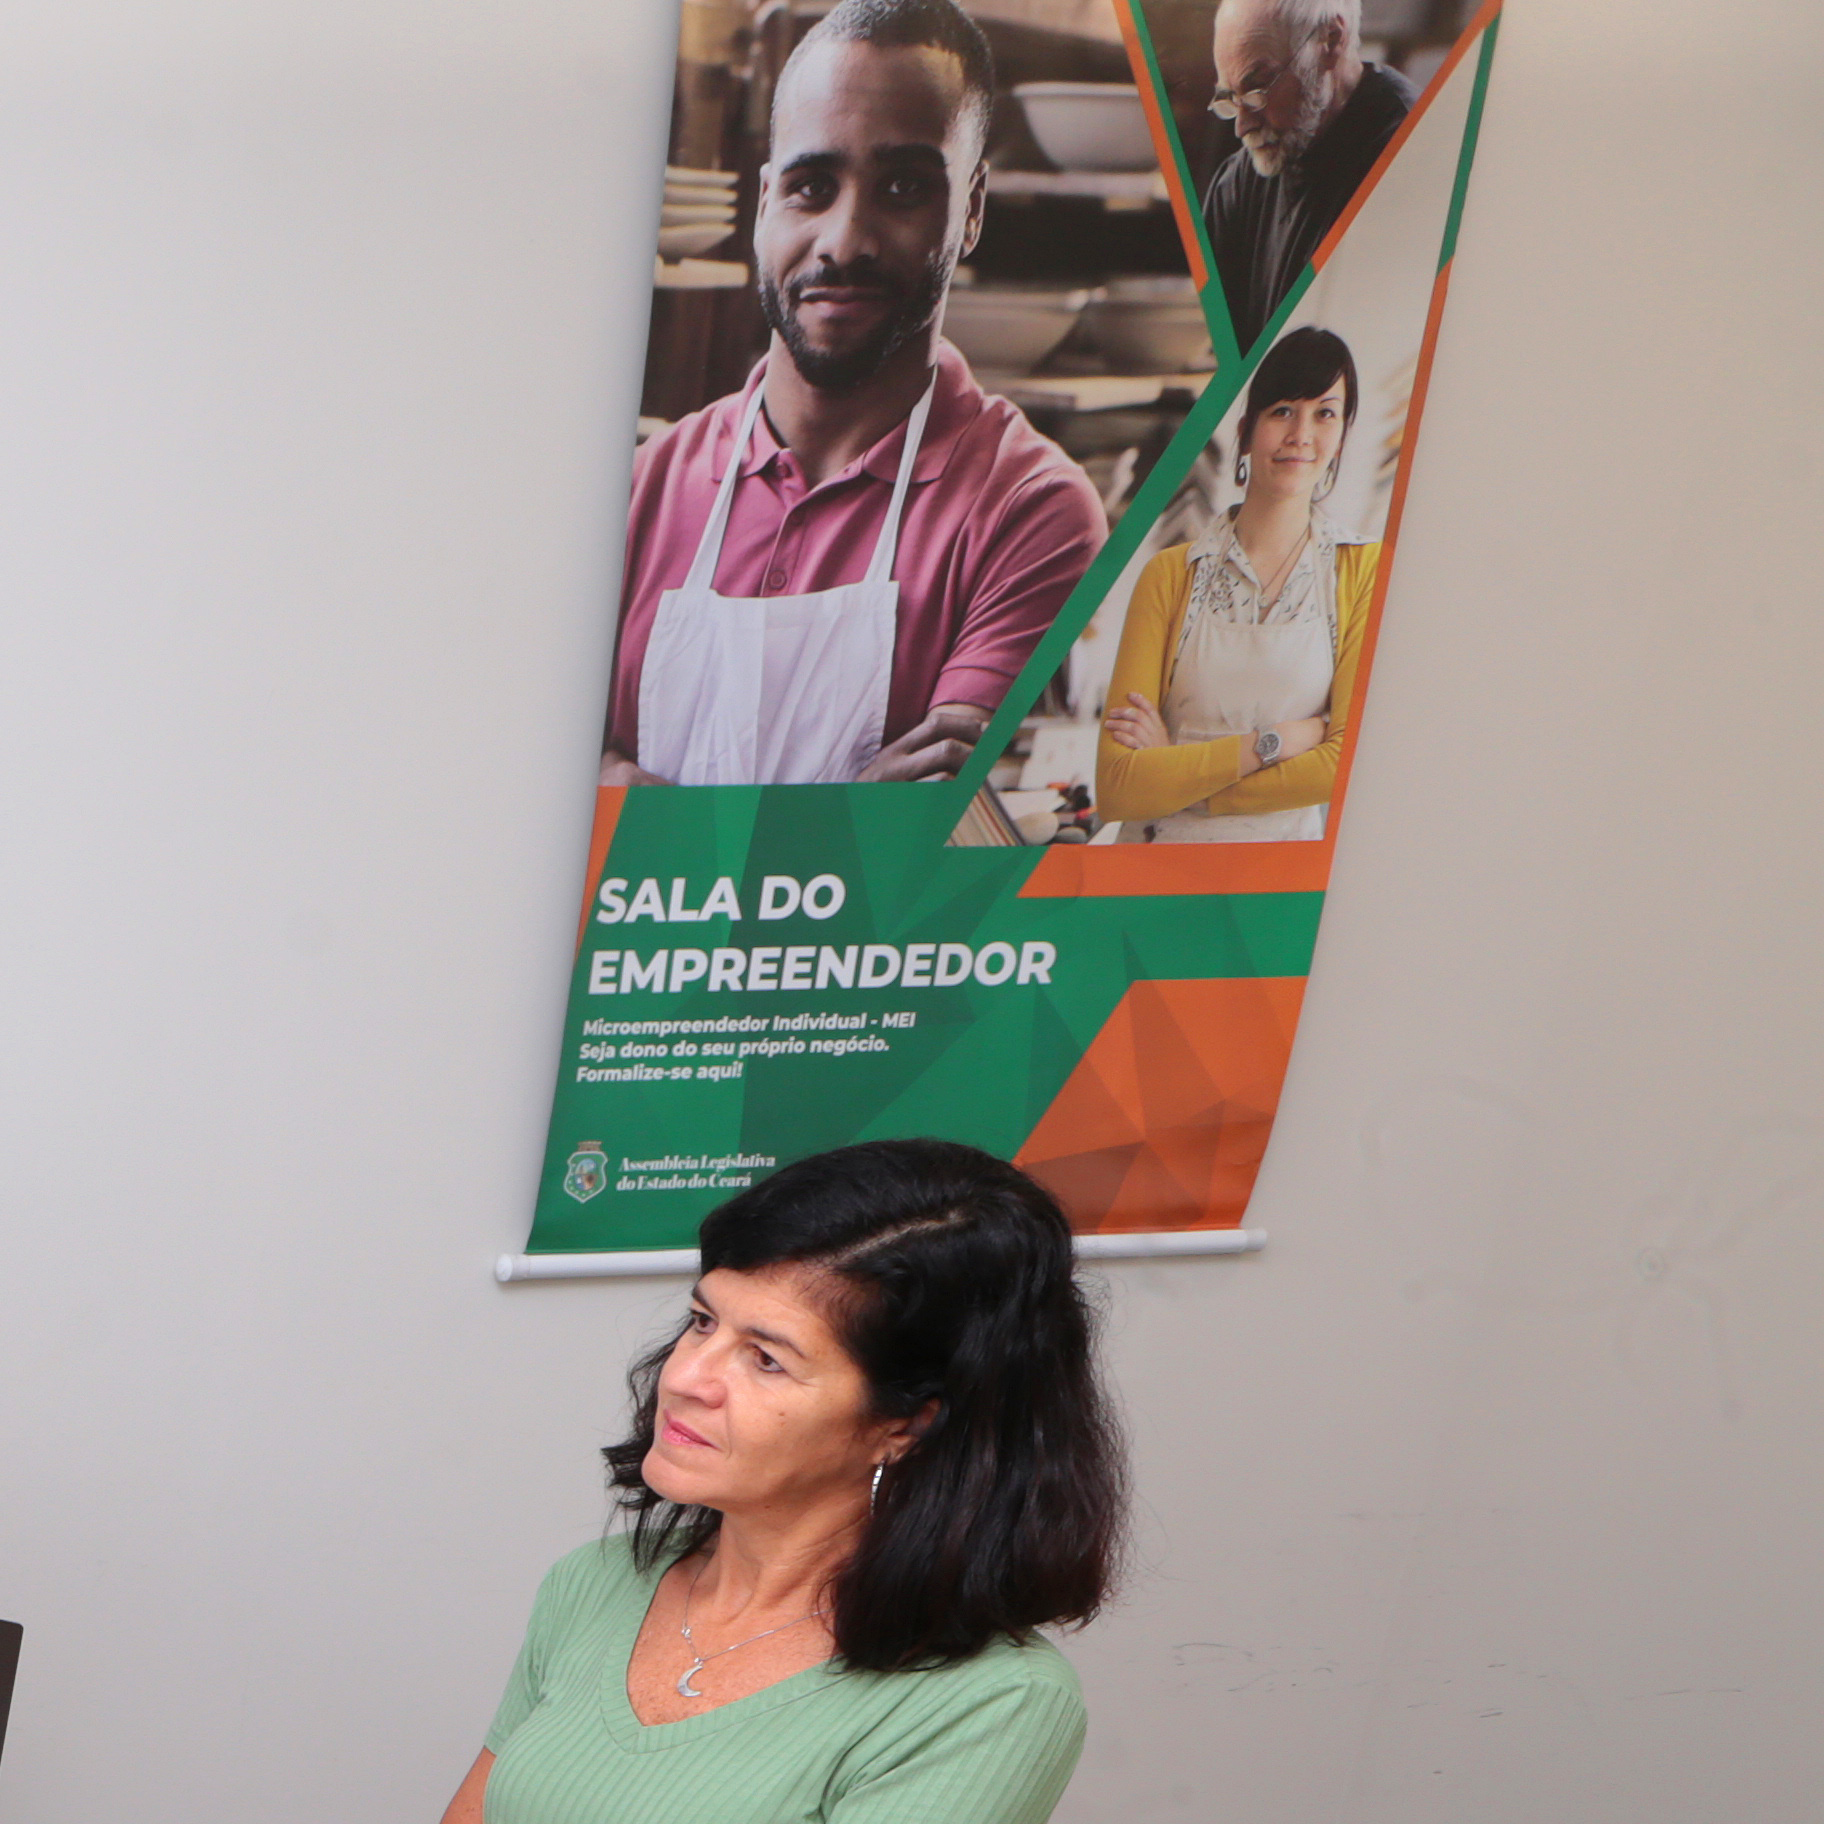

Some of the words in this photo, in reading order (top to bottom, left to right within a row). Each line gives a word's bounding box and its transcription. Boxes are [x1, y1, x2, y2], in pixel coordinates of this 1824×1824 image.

[596, 876, 742, 924] SALA
[758, 873, 846, 920] DO
[588, 942, 1058, 995] EMPREENDEDOR
[583, 1015, 770, 1038] Microempreendedor
[772, 1012, 868, 1031] Individual
[881, 1011, 916, 1029] MEI
[579, 1041, 616, 1063] Seja
[619, 1041, 669, 1058] dono
[671, 1039, 698, 1057] do
[701, 1042, 736, 1056] seu
[738, 1036, 806, 1059] próprio
[809, 1034, 890, 1057] negócio.
[576, 1063, 693, 1083] Formalize-se
[696, 1060, 744, 1083] aqui!
[618, 1154, 699, 1173] Assembleia
[699, 1153, 776, 1173] Legislativa
[616, 1175, 636, 1192] do
[637, 1174, 687, 1191] Estado
[687, 1173, 707, 1190] do
[708, 1173, 753, 1190] Ceará
